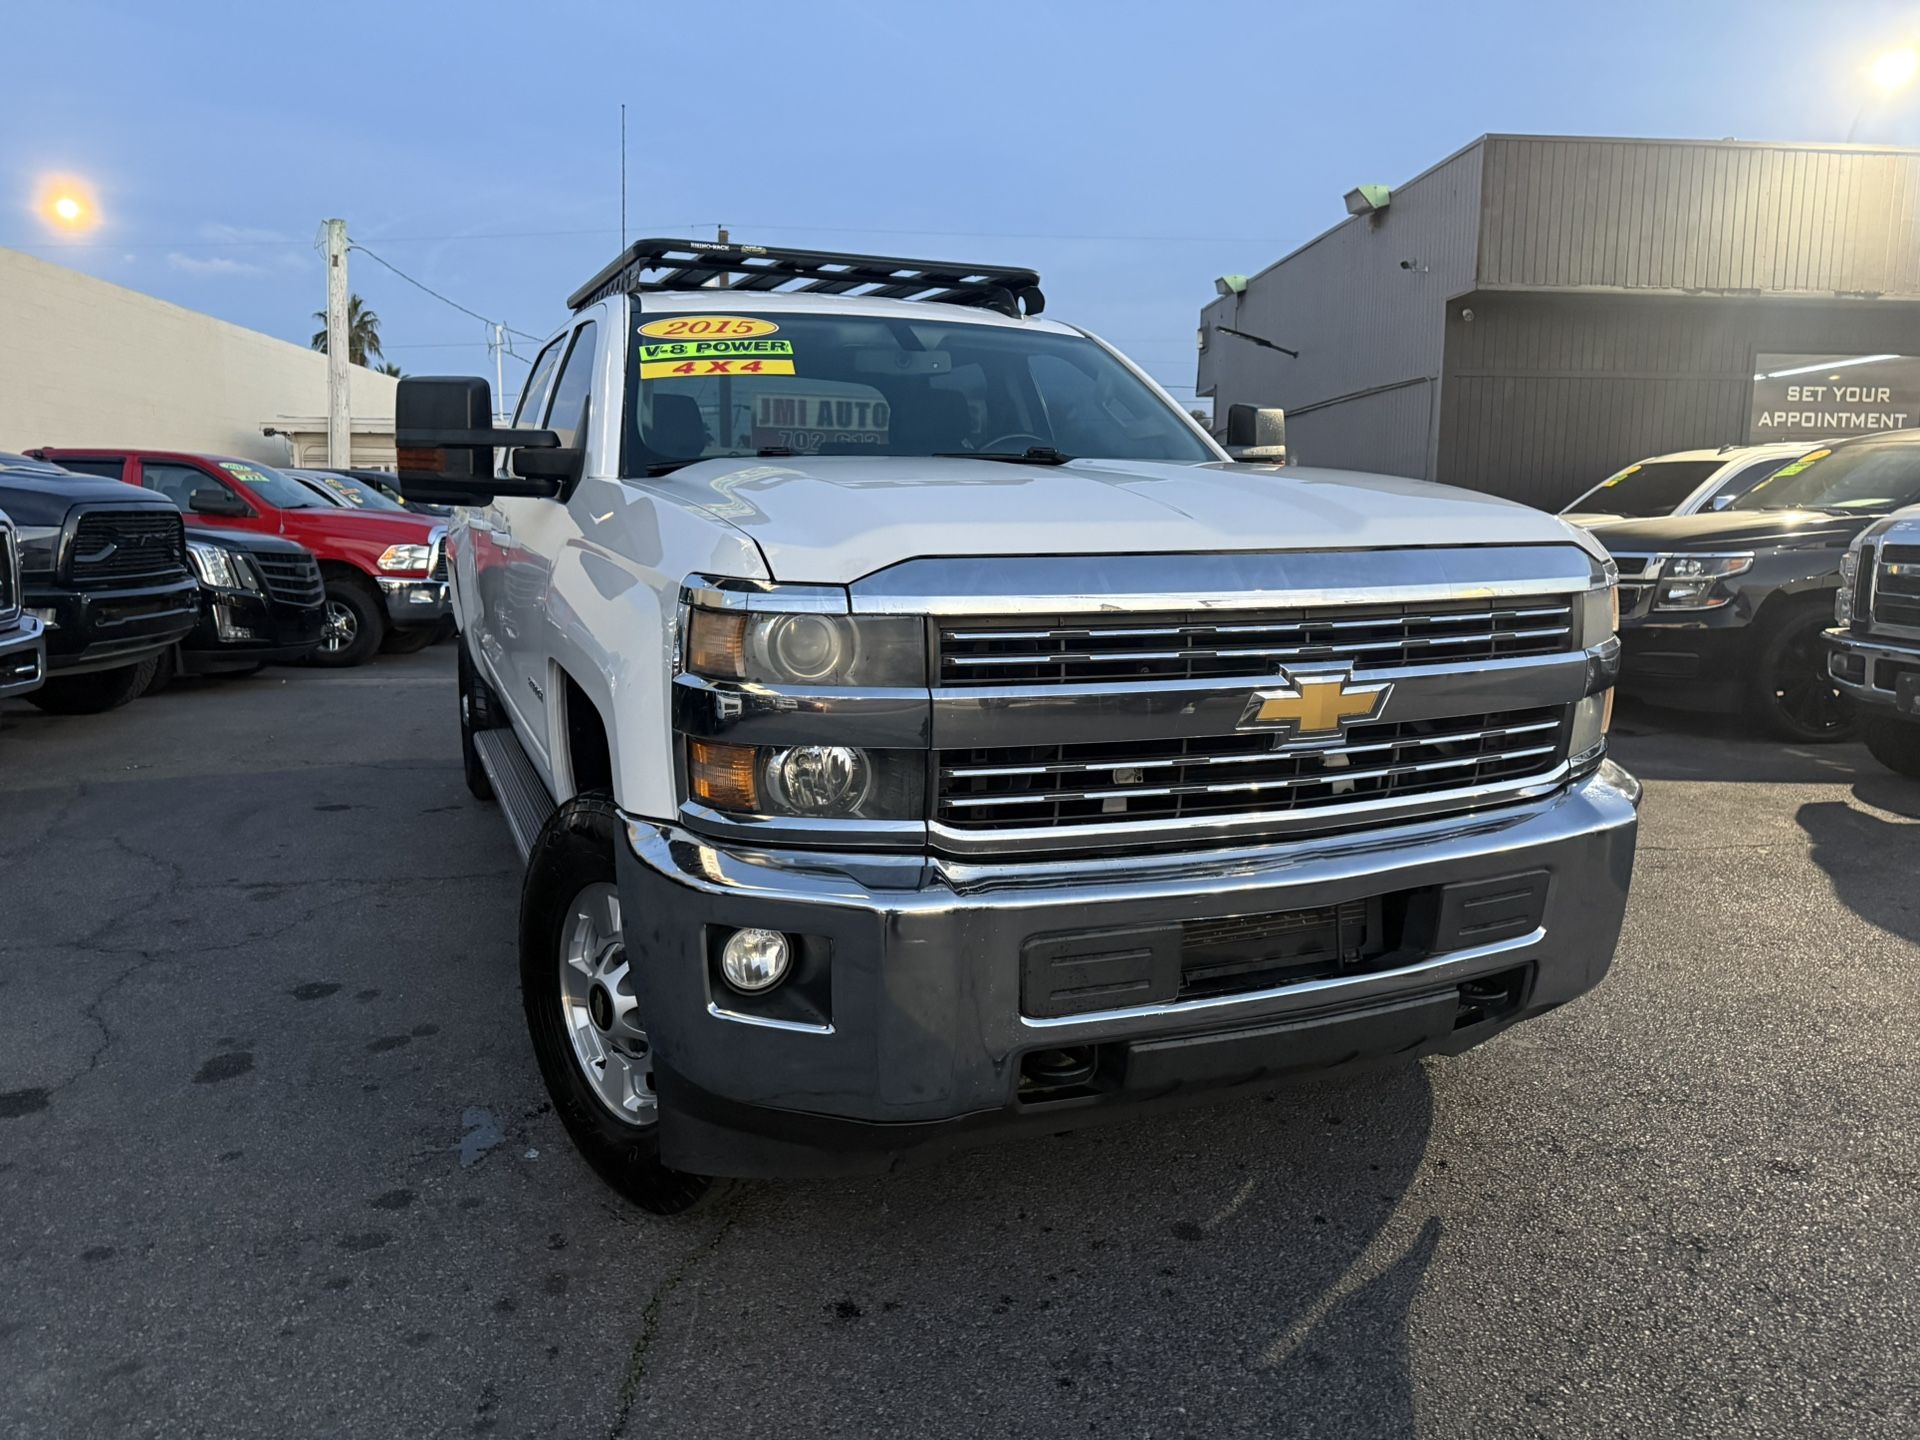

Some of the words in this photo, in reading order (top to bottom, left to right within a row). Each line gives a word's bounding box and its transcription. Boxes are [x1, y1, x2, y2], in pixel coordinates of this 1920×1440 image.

[662, 321, 756, 336] 2015
[644, 344, 688, 357] V-8
[696, 341, 789, 354] POWER
[1787, 386, 1827, 402] SET
[1833, 387, 1890, 403] YOUR
[816, 400, 889, 430] AUTO
[1758, 411, 1907, 429] APPOINTMENT
[779, 430, 825, 451] 702
